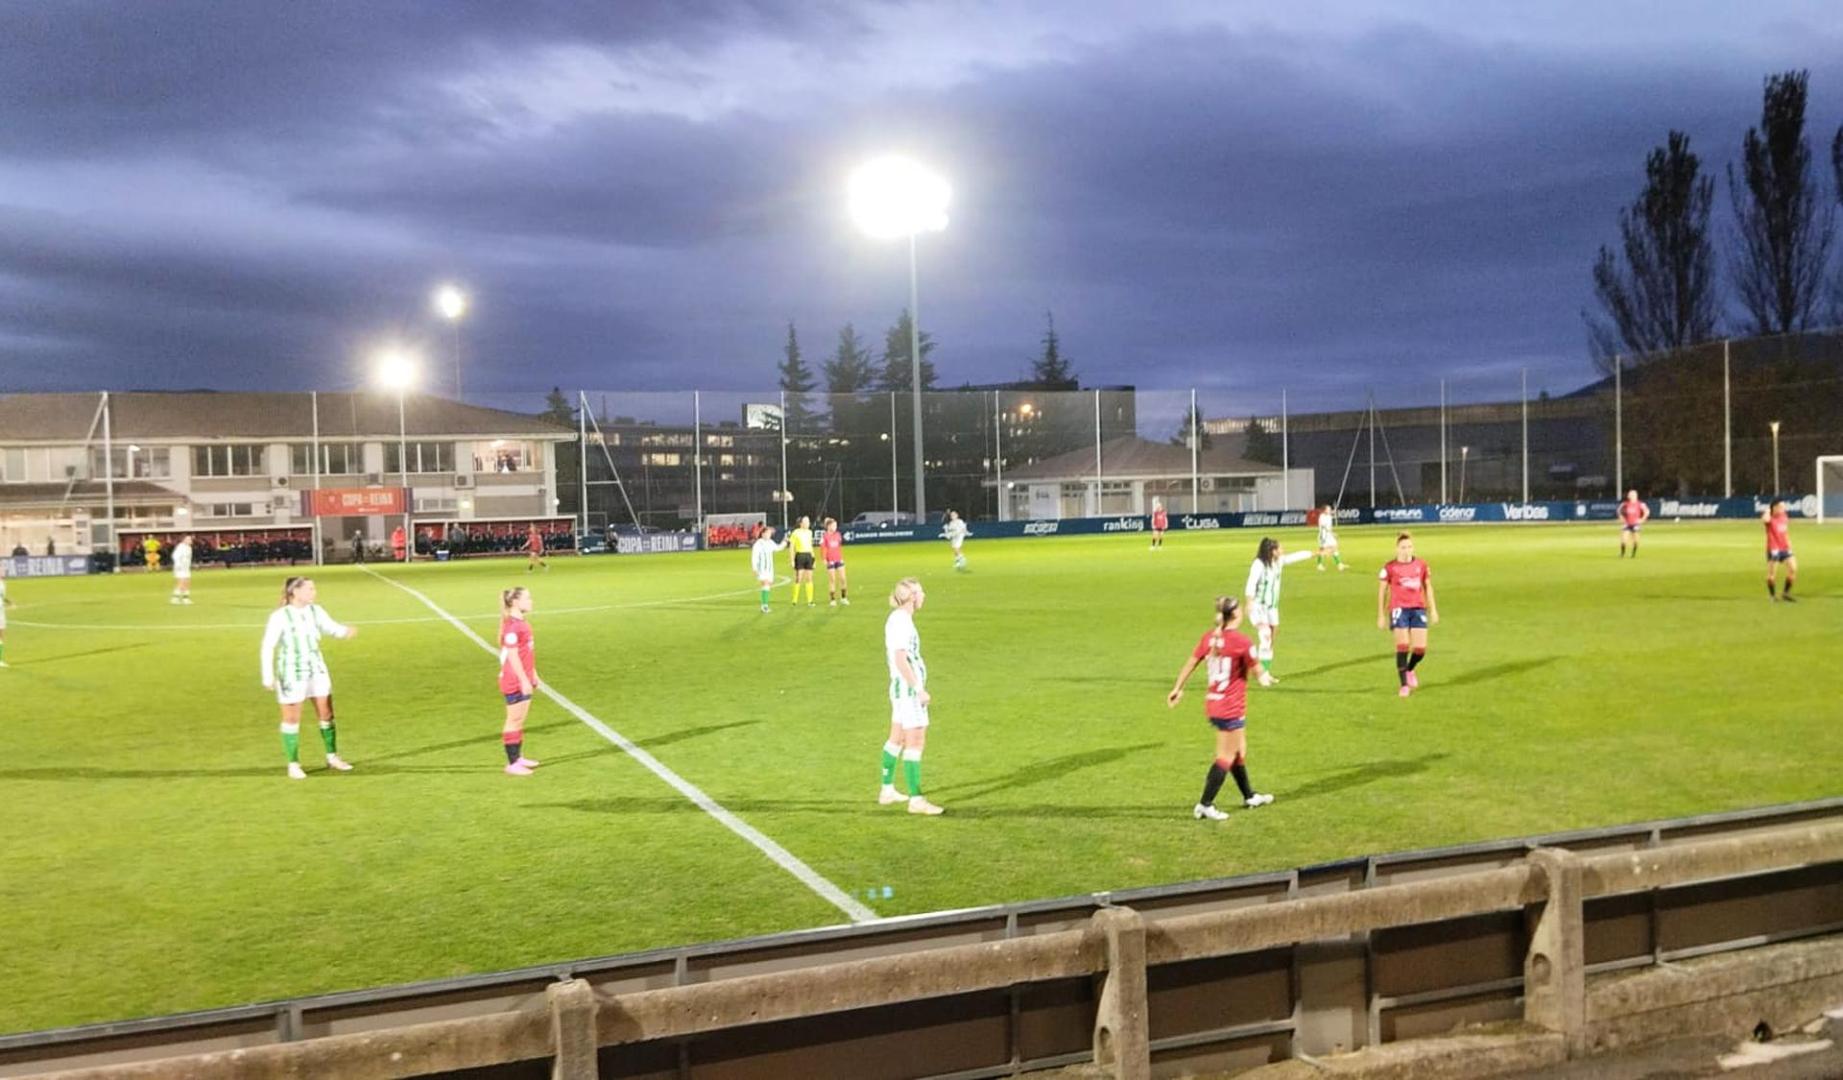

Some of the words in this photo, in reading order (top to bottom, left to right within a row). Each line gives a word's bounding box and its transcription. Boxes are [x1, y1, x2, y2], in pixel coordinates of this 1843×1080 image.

[1103, 517, 1144, 531] ranking
[618, 536, 643, 553] COPA
[651, 535, 679, 552] REINA
